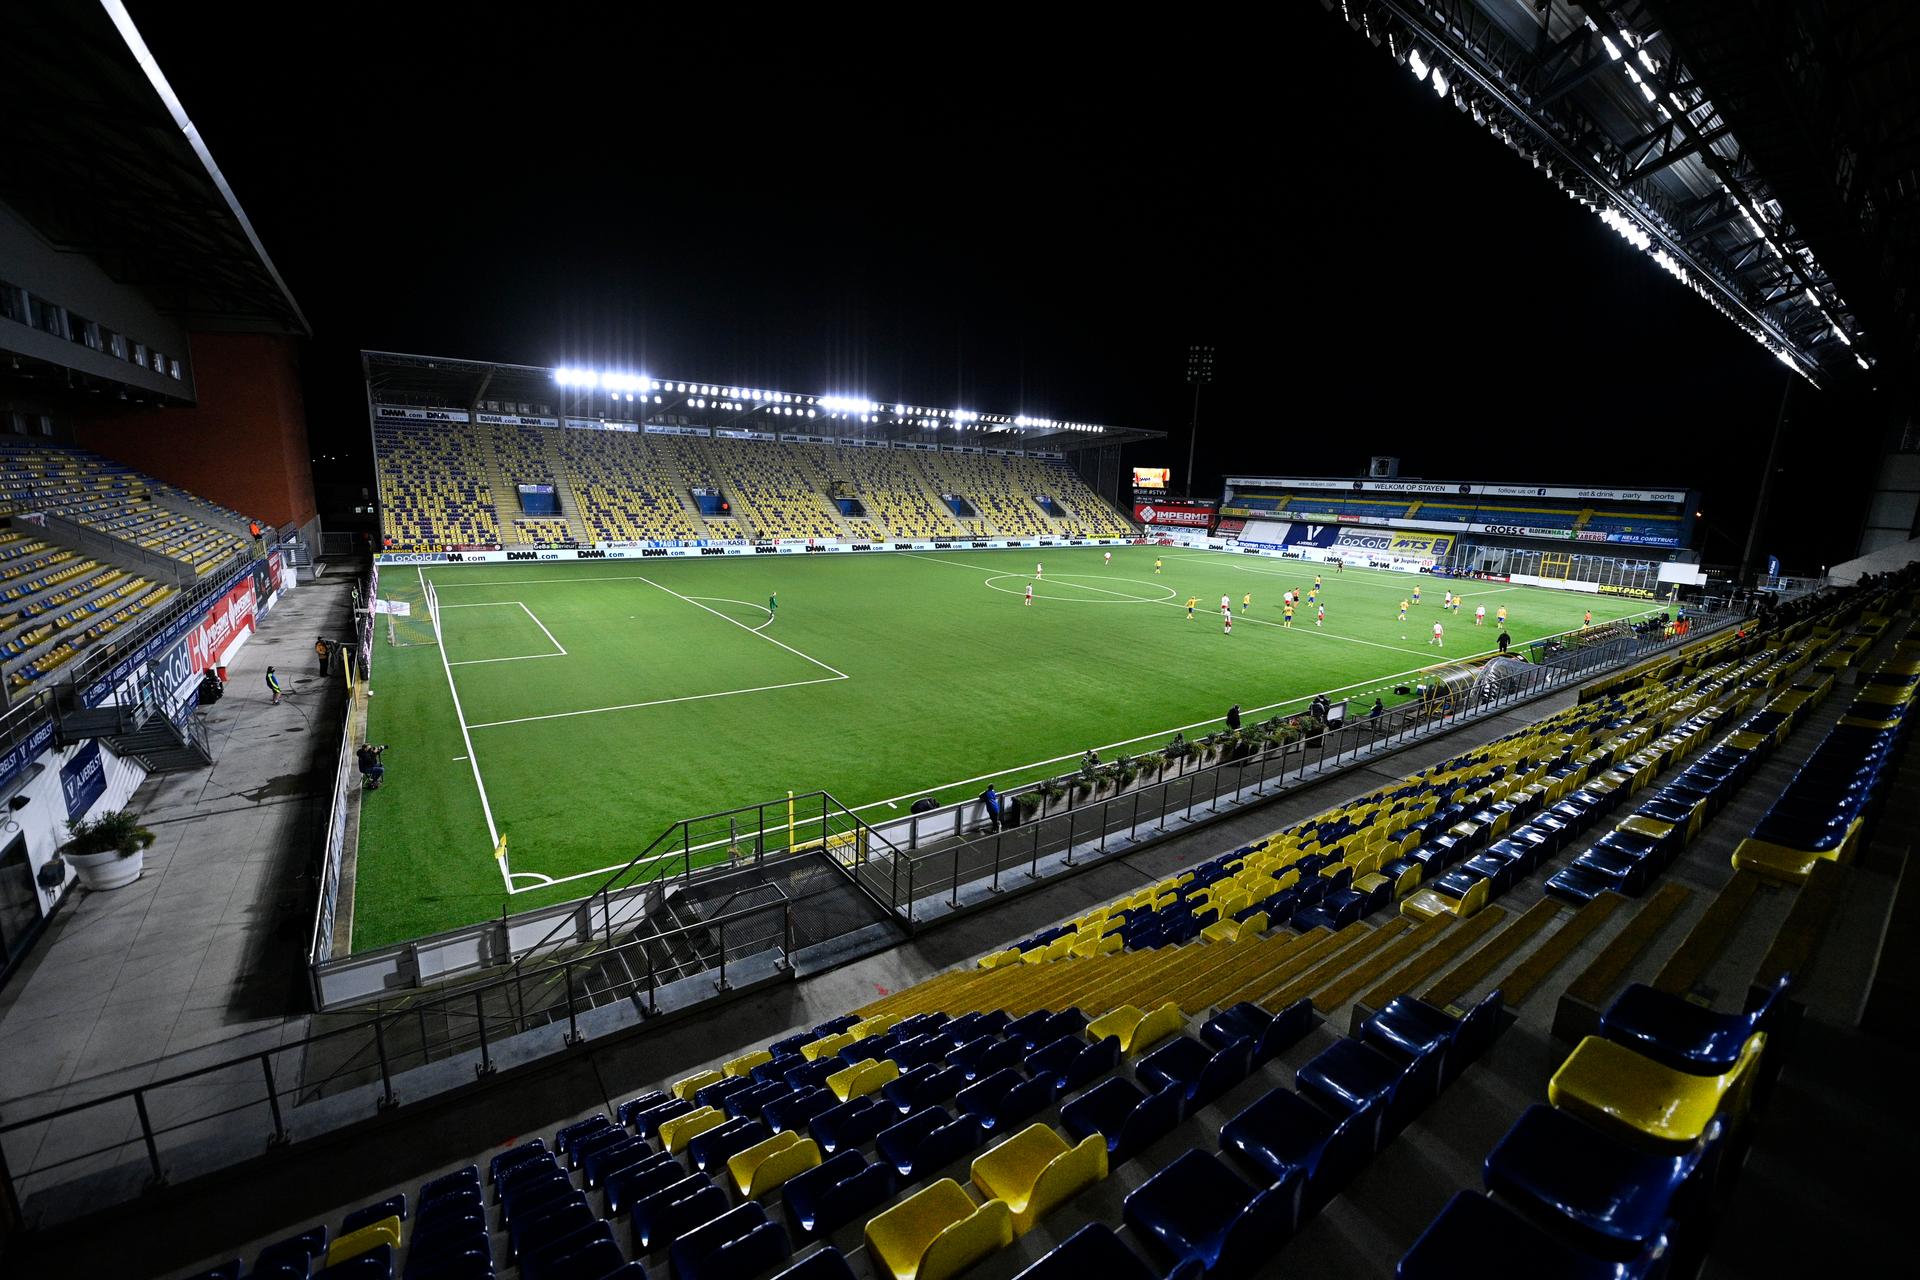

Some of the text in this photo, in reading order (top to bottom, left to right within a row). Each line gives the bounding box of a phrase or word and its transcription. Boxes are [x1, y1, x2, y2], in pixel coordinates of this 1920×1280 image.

[1157, 511, 1209, 520] IMPERMO
[1485, 525, 1518, 534] CROES
[1338, 535, 1390, 549] TopCold
[1393, 540, 1432, 549] MTS
[413, 544, 443, 553] CELIS
[391, 553, 433, 562] TopCold
[29, 724, 54, 751] A.VERELST
[76, 753, 102, 789] A.VERELST
